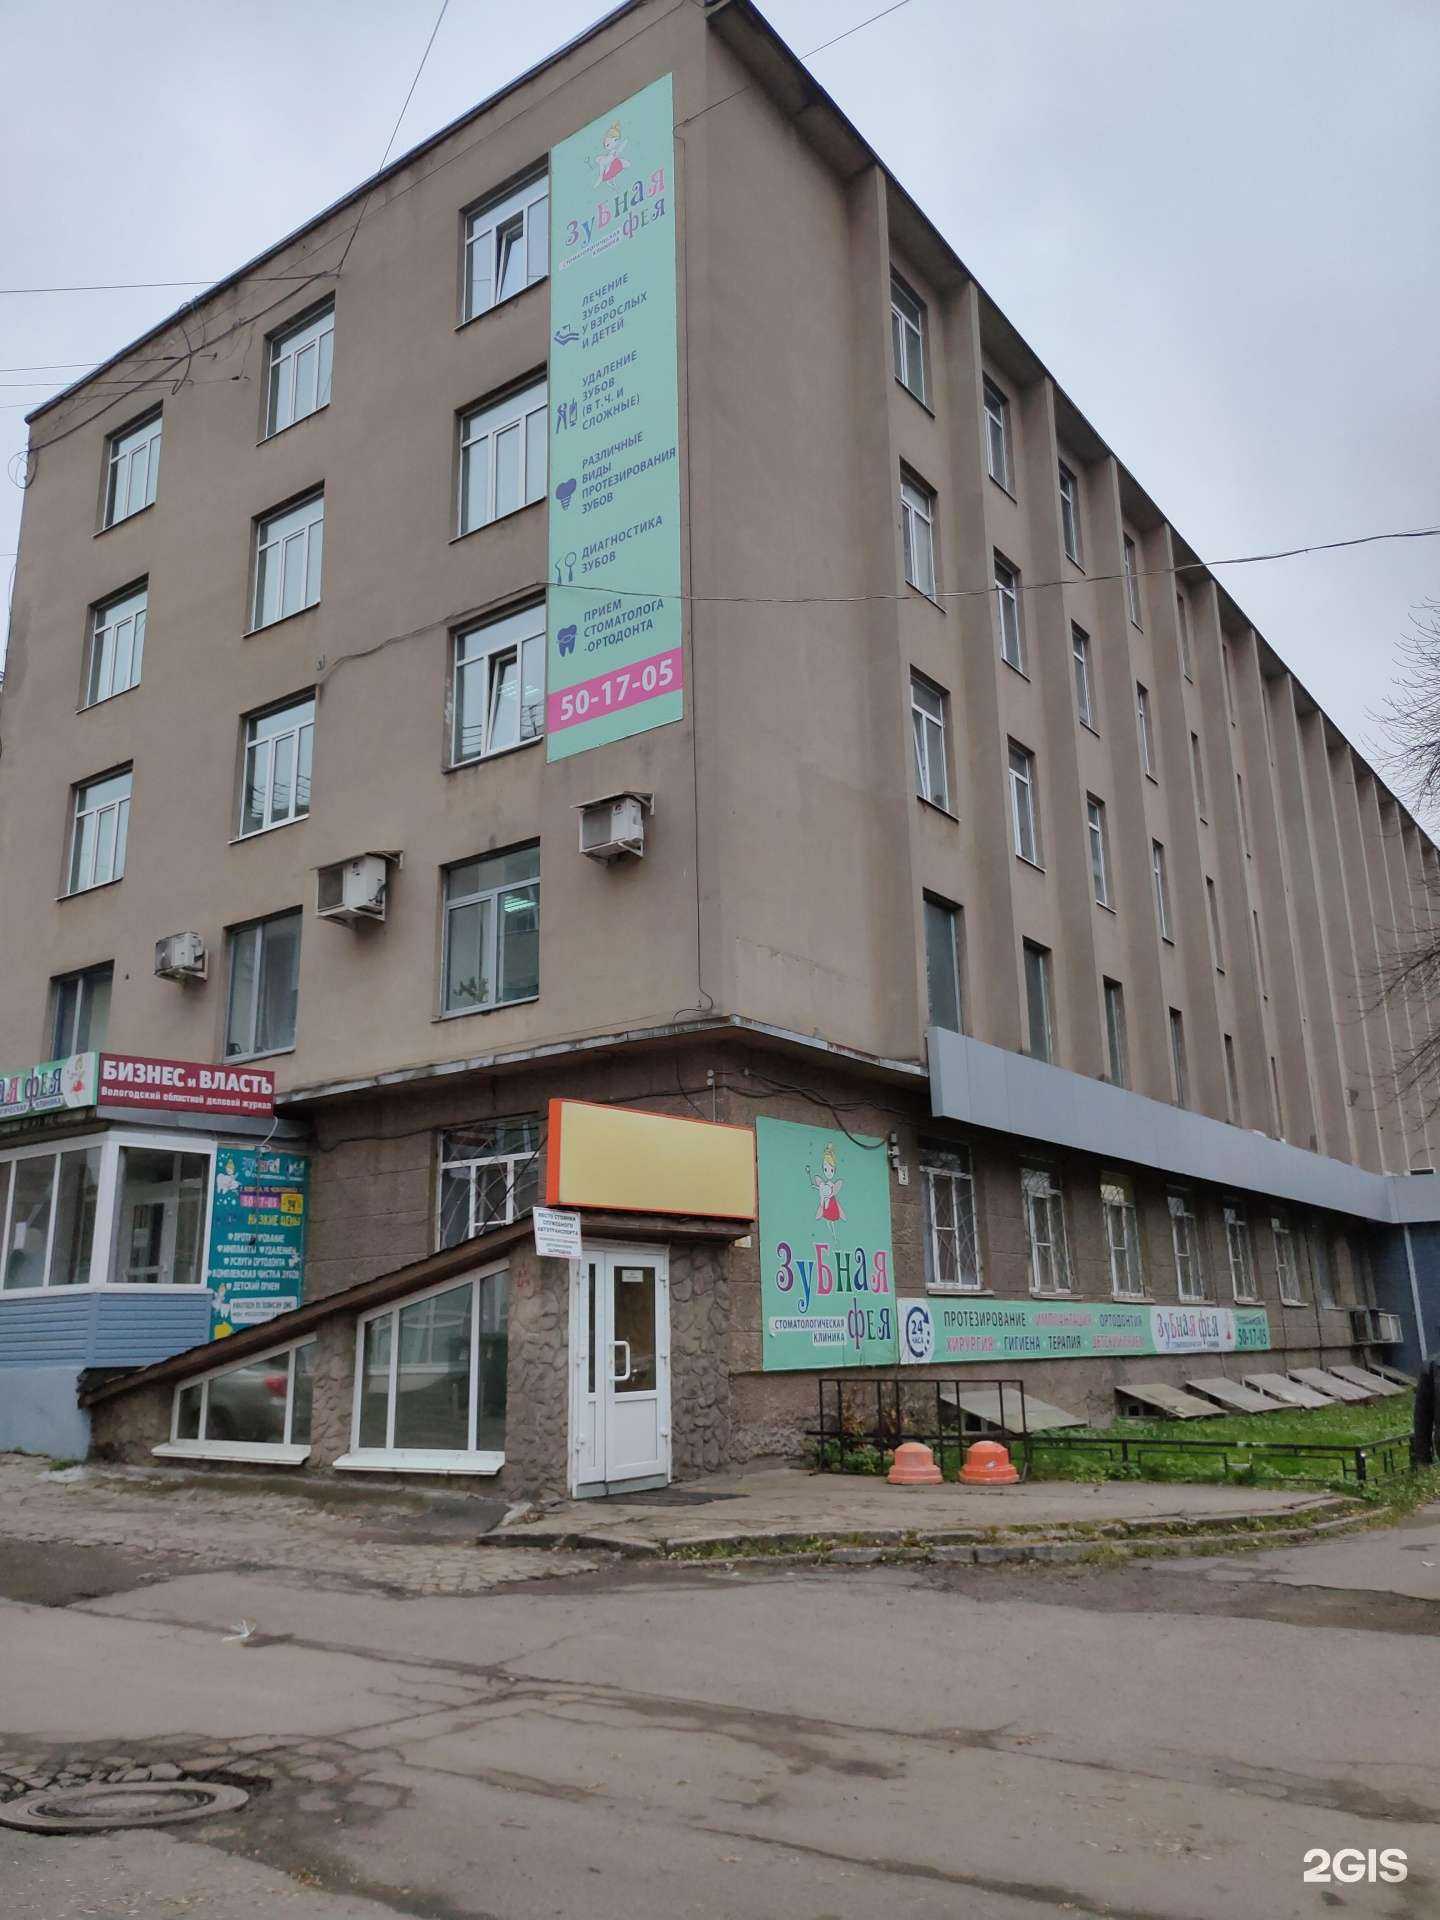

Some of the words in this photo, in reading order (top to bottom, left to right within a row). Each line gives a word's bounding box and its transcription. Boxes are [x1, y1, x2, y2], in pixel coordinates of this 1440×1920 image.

[582, 272, 630, 307] ЛЕЧЕНИЕ
[582, 295, 615, 321] ЗУБОВ
[590, 291, 648, 330] ВЗРОСЛЫХ
[582, 338, 589, 350] И
[591, 318, 625, 347] ДЕТЕЙ
[582, 350, 639, 387] УДАЛЕНИЕ
[582, 376, 616, 402] ЗУБОВ
[582, 392, 641, 430] СЛОЖНЫЕ)
[582, 431, 644, 469] РАЗЛИЧНЫЕ
[582, 462, 612, 484] ВИДЫ
[582, 447, 677, 499] ПРОТЕЗИРОВАНИЯ
[581, 492, 614, 515] ЗУБОВ
[582, 515, 663, 560] ДИАГНОСТИКА
[581, 551, 616, 574] ЗУБОВ
[583, 598, 665, 638] СТОМАТОЛОГА
[584, 598, 622, 623] ПРИЕМ
[560, 657, 673, 722] 50-17-05
[102, 1059, 185, 1087] БИЗНЕС
[199, 1070, 273, 1095] ВЛАСТЬ
[101, 1086, 161, 1100] Вологодский
[163, 1092, 205, 1104] областной
[206, 1096, 241, 1108] деловой
[774, 1318, 845, 1330] СТОМАТОЛОГИЧЕСКАЯ
[911, 1319, 924, 1334] 24
[944, 1310, 1027, 1328] ПРОТЕЗИРОВАНИЕ
[813, 1331, 845, 1344] КЛИНИКА
[945, 1335, 994, 1352] ХИРУРГИЯ
[1003, 1335, 1041, 1351] ГИГИЕНА
[1047, 1335, 1082, 1351] ТЕРАПИЯ
